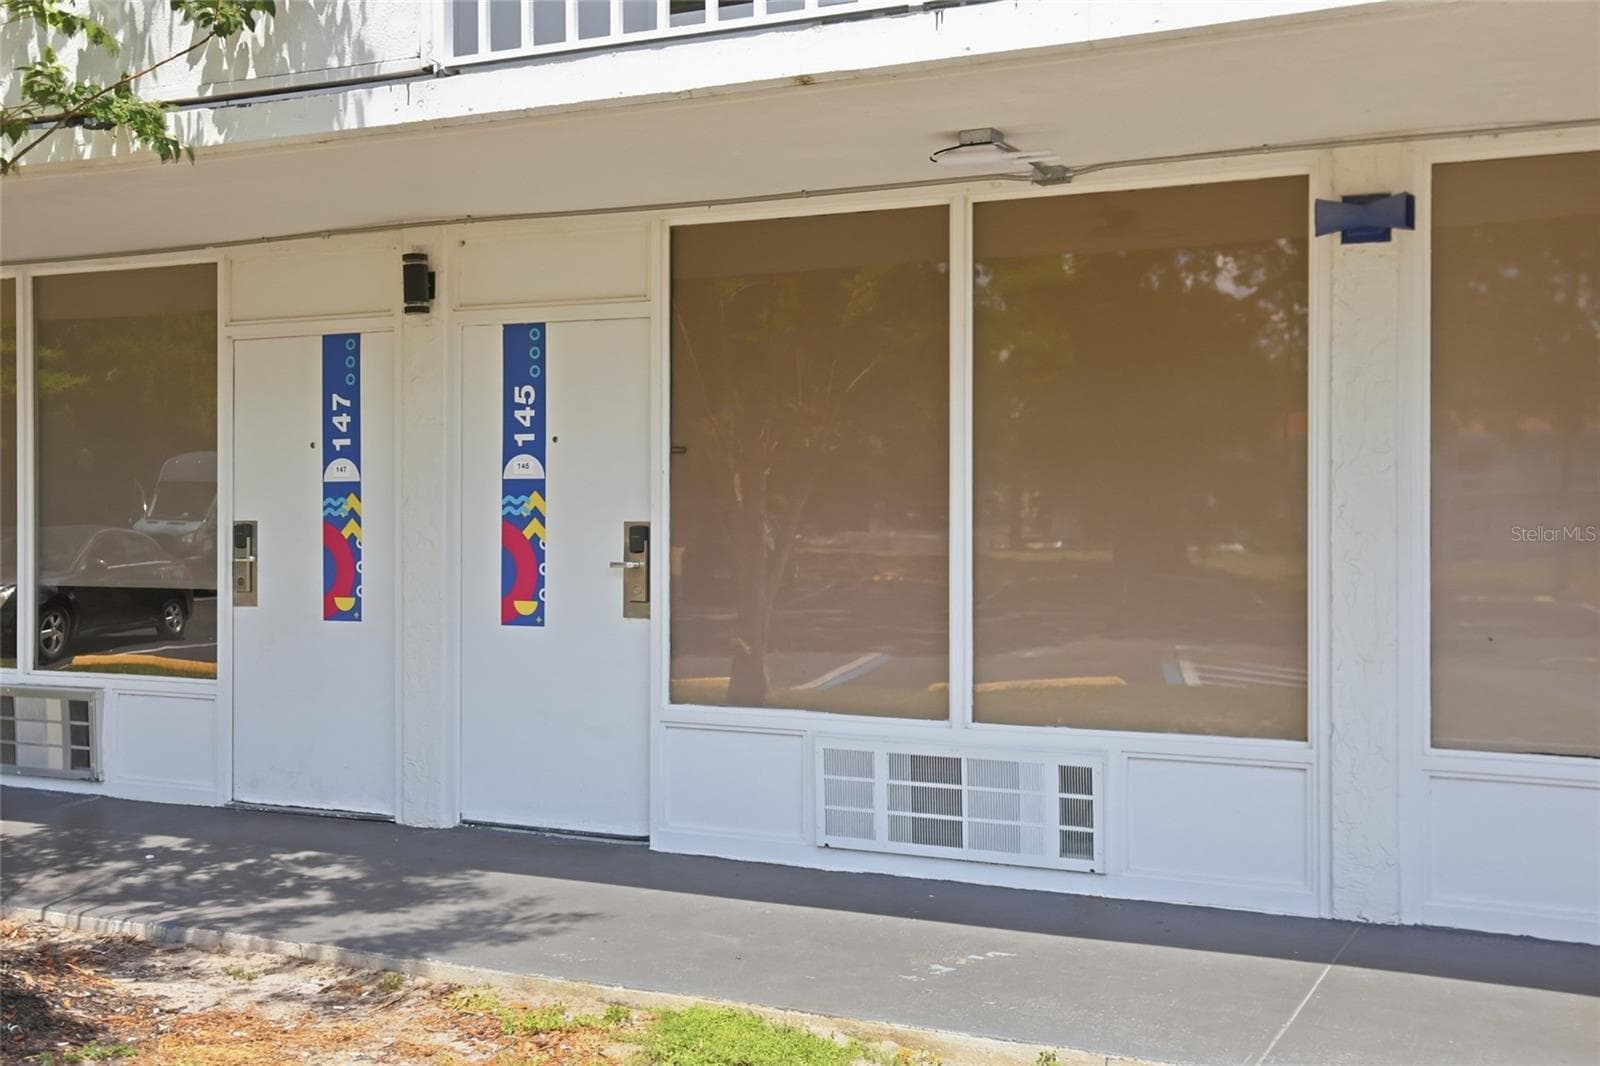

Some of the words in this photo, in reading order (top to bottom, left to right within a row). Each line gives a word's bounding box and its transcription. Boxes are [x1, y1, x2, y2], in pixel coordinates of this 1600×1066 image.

[332, 393, 351, 451] 147
[514, 385, 535, 447] 145
[517, 462, 530, 470] 145
